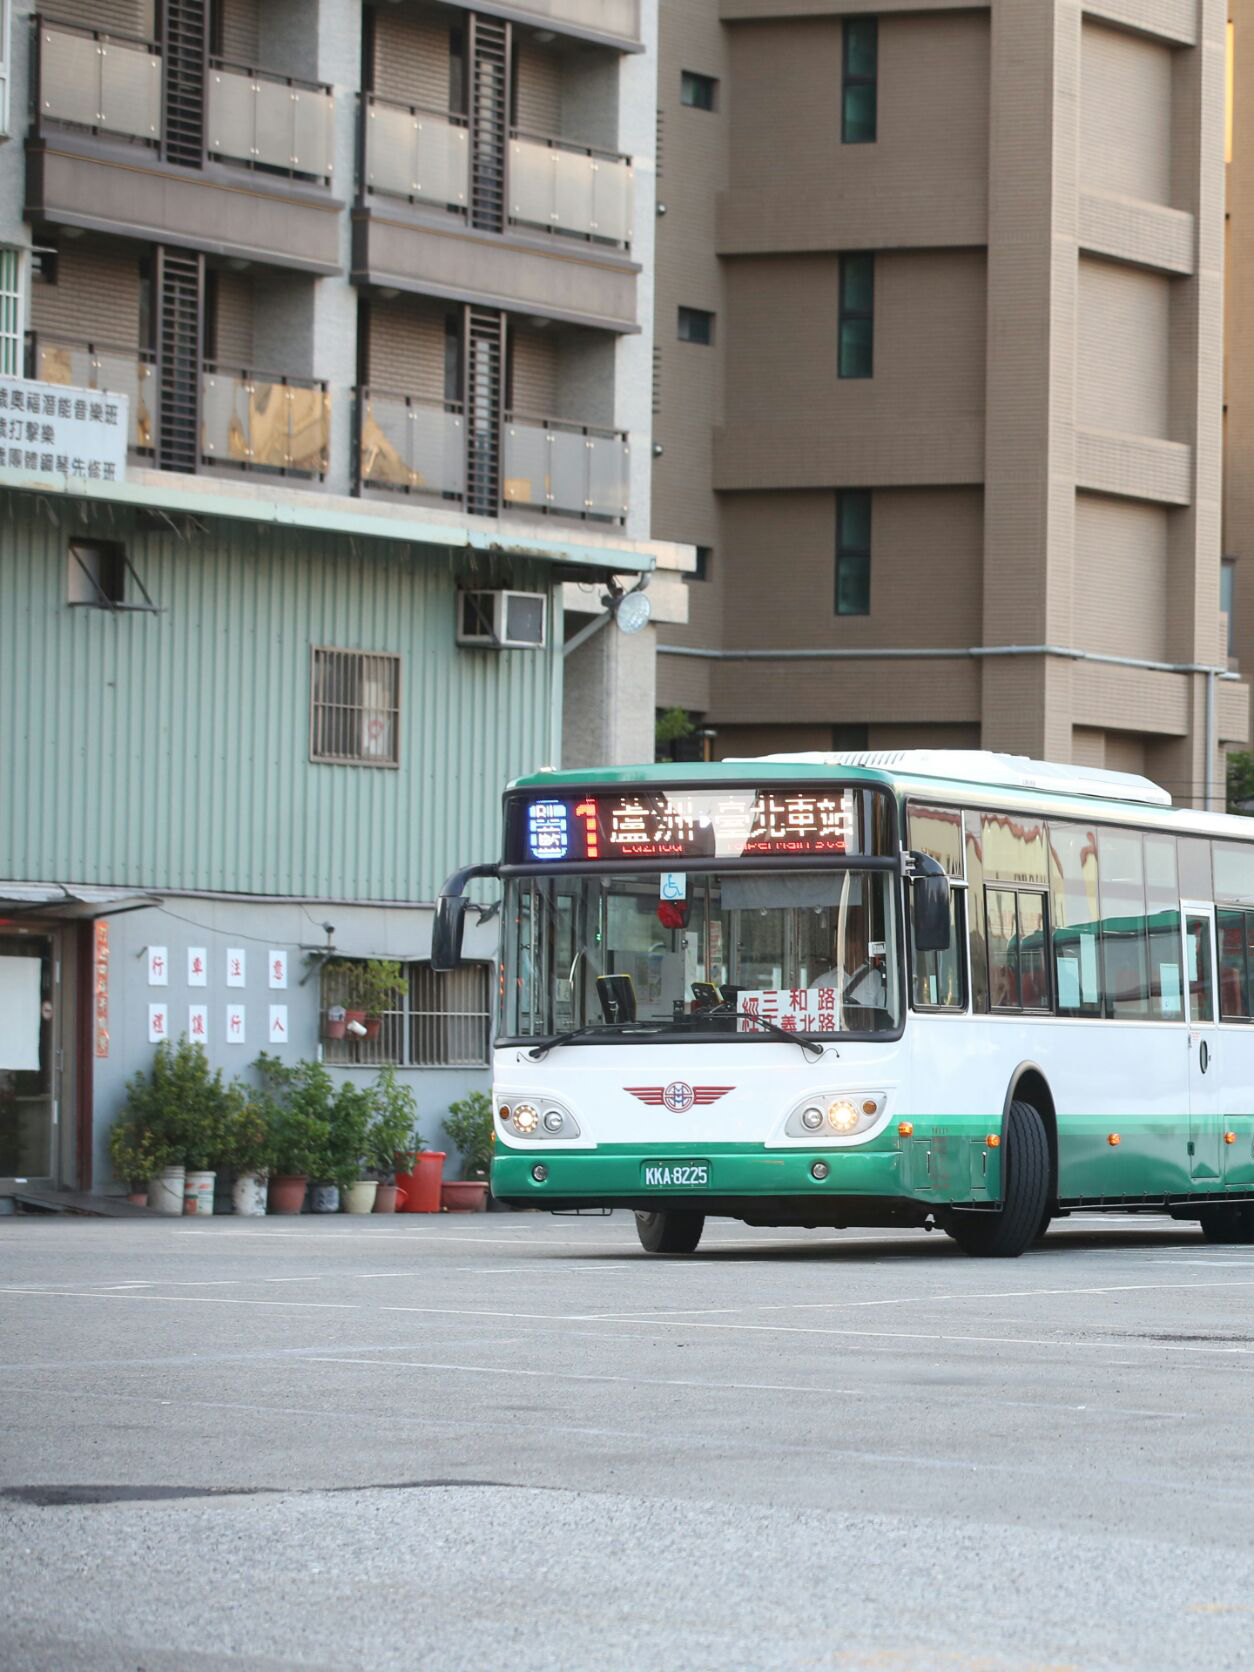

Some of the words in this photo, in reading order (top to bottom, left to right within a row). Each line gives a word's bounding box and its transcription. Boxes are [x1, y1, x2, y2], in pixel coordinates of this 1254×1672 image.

[761, 987, 836, 1013] 三和路
[645, 1166, 708, 1185] KKA-8225
